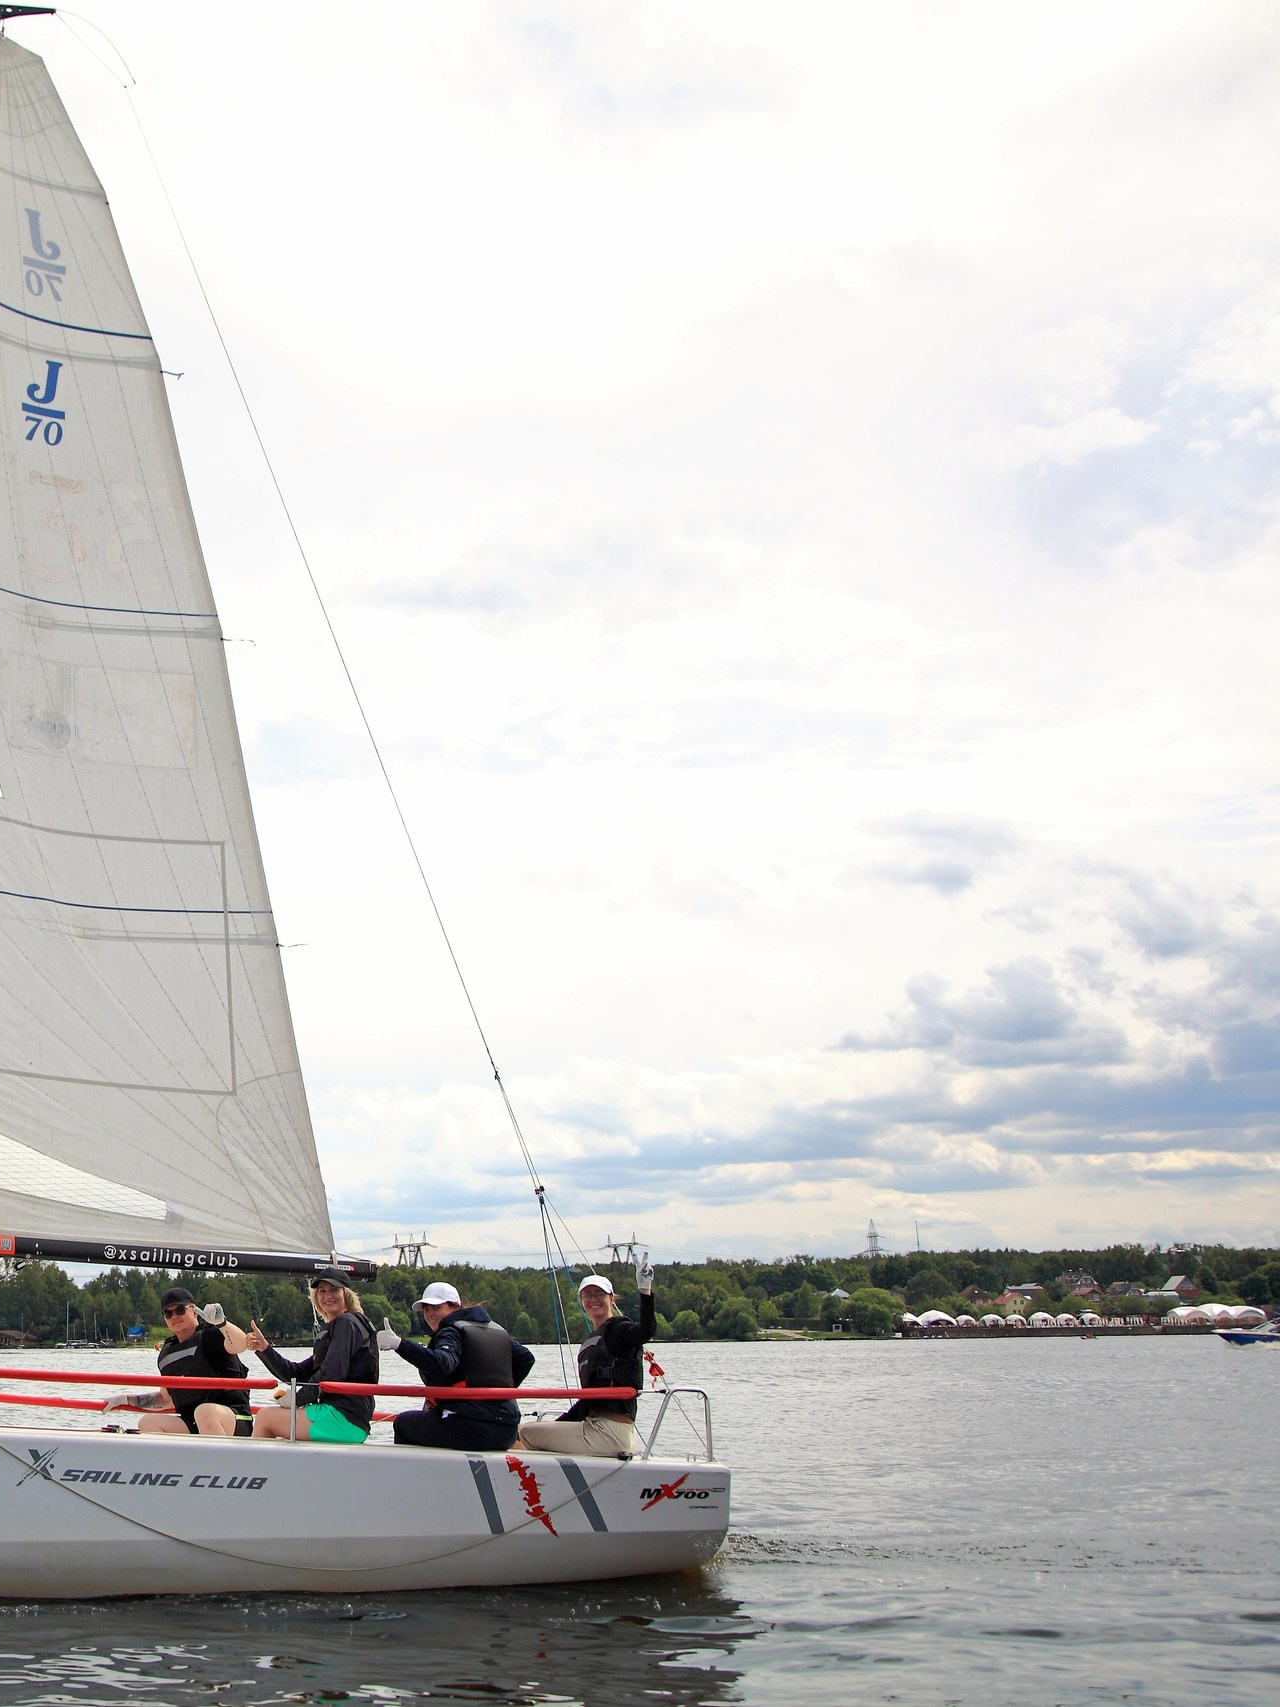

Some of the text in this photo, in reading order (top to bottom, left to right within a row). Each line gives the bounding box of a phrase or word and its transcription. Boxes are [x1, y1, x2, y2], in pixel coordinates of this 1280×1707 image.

[26, 360, 63, 404] J
[24, 415, 63, 446] 70
[103, 1245, 239, 1268] @xsailingclub
[60, 1469, 183, 1487] SAILING
[189, 1475, 268, 1490] CLUB
